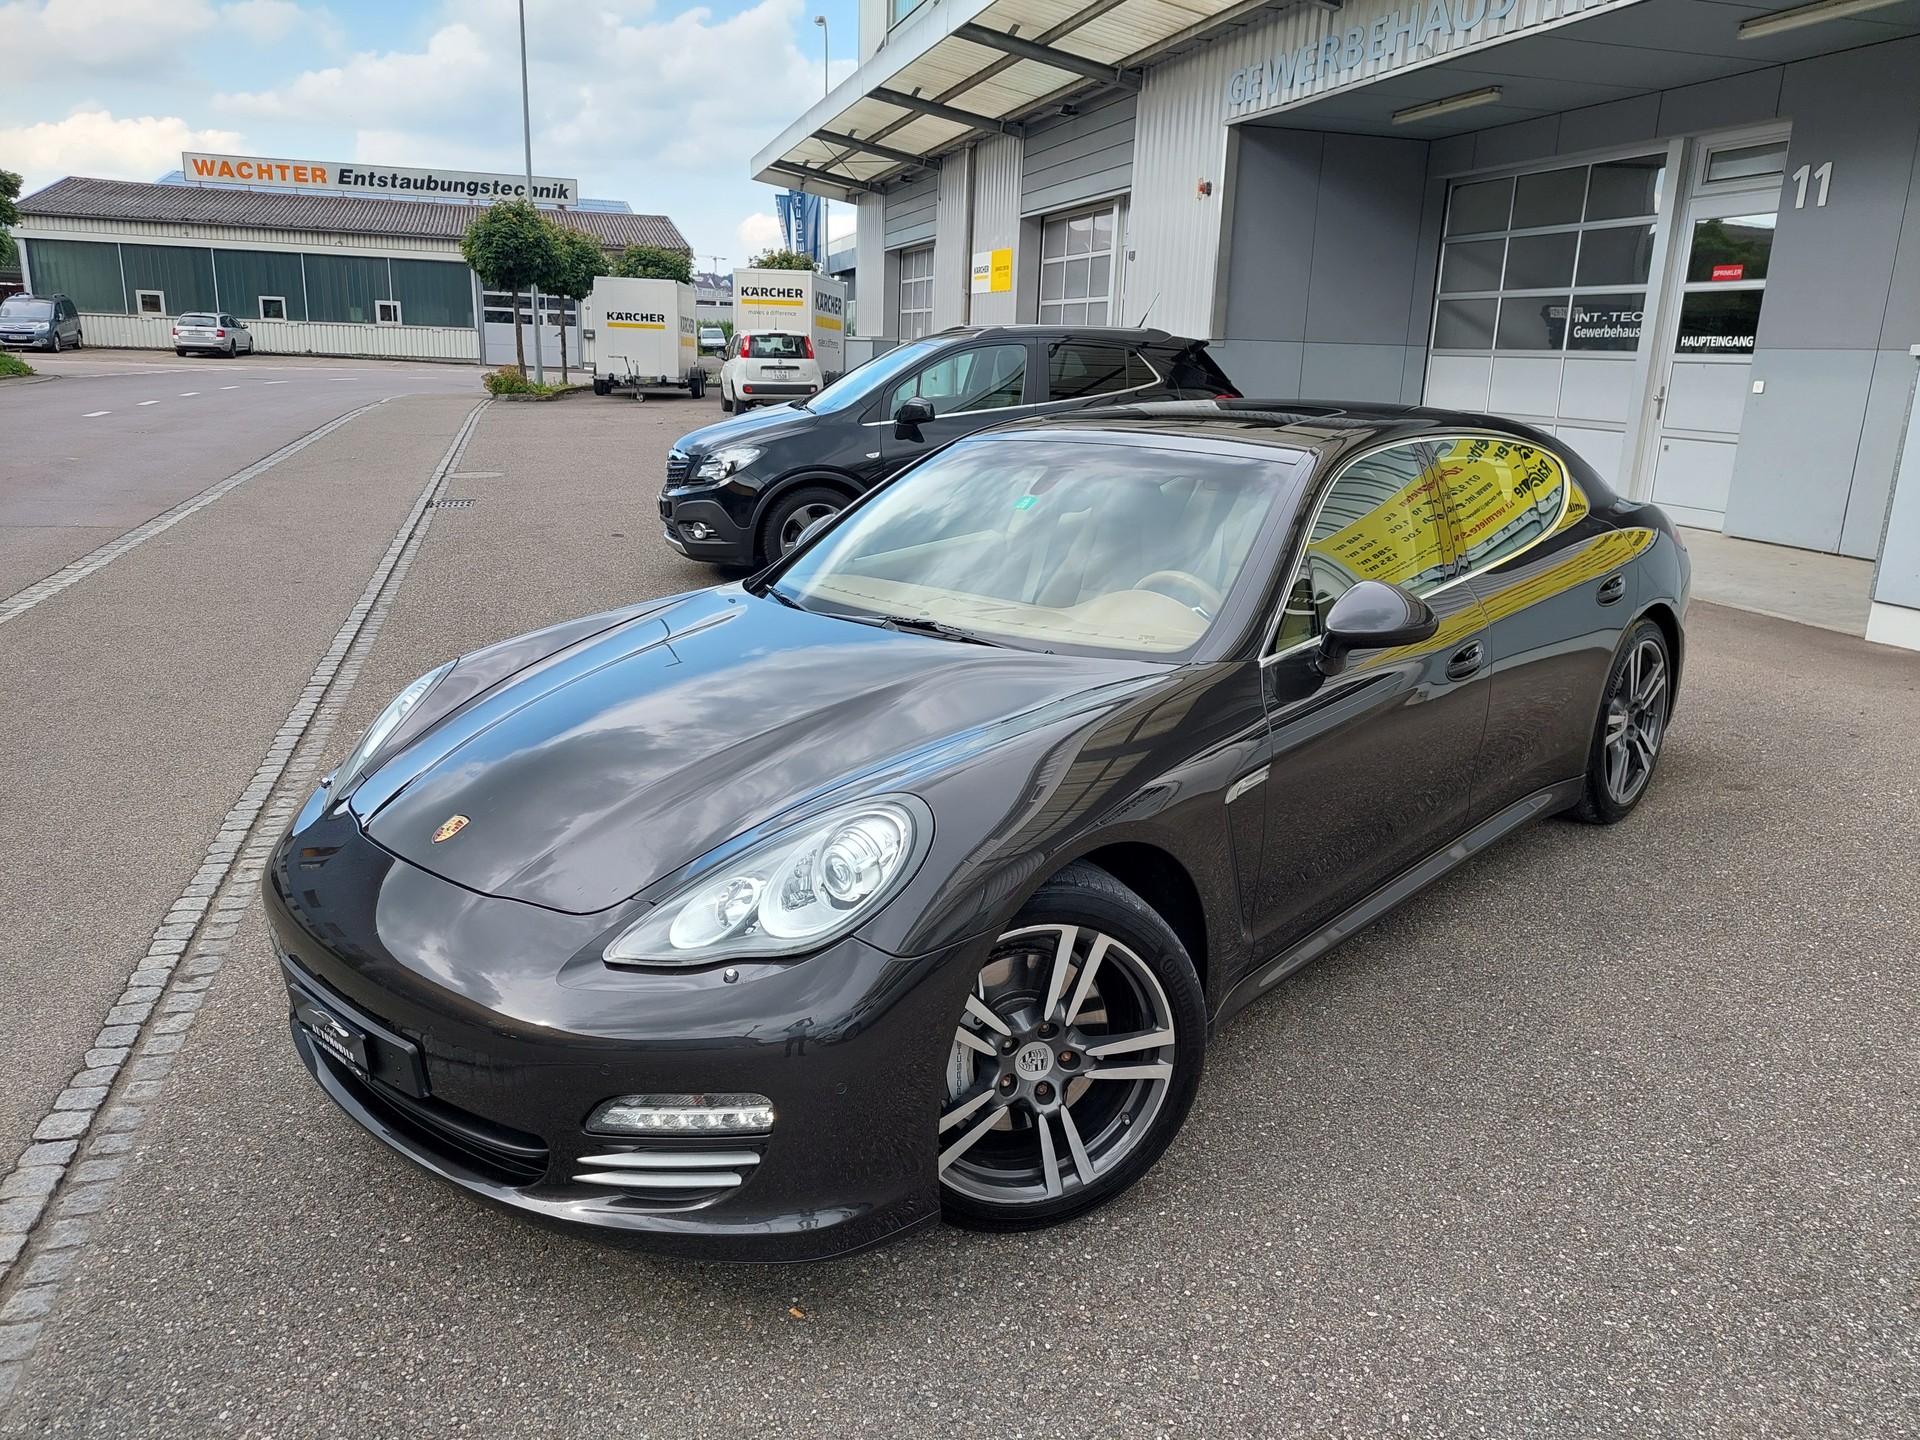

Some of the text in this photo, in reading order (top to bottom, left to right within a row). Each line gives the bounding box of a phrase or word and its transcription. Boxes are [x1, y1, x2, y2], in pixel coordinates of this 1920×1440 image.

[192, 158, 327, 184] WACHTER
[1792, 161, 1834, 209] 11
[1712, 268, 1743, 277] SPRINKLER
[741, 286, 804, 299] KÄRCHER
[606, 311, 666, 323] KÄRCHER
[769, 308, 798, 317] difference
[1573, 324, 1642, 339] Gewerbehaus
[1681, 335, 1754, 348] HAUPTEINGANG
